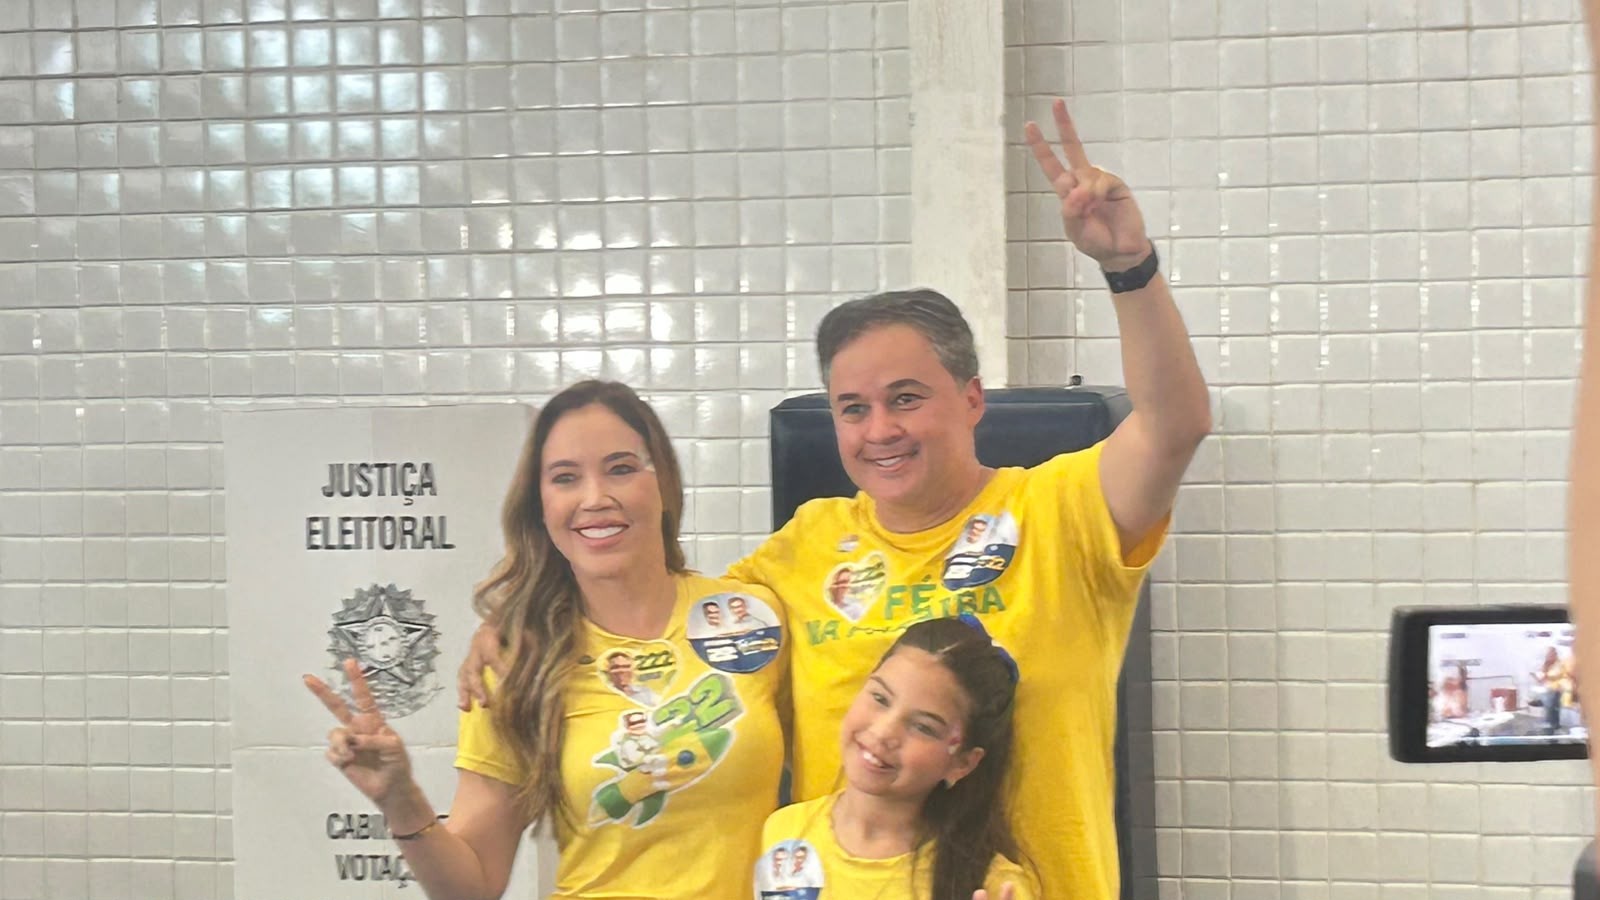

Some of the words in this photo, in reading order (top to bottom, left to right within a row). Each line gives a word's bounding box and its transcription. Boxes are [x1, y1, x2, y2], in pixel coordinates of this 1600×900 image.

[321, 461, 438, 507] JUSTIÇA
[305, 515, 456, 551] ELEITORAL
[334, 853, 417, 889] VOTAÇ
